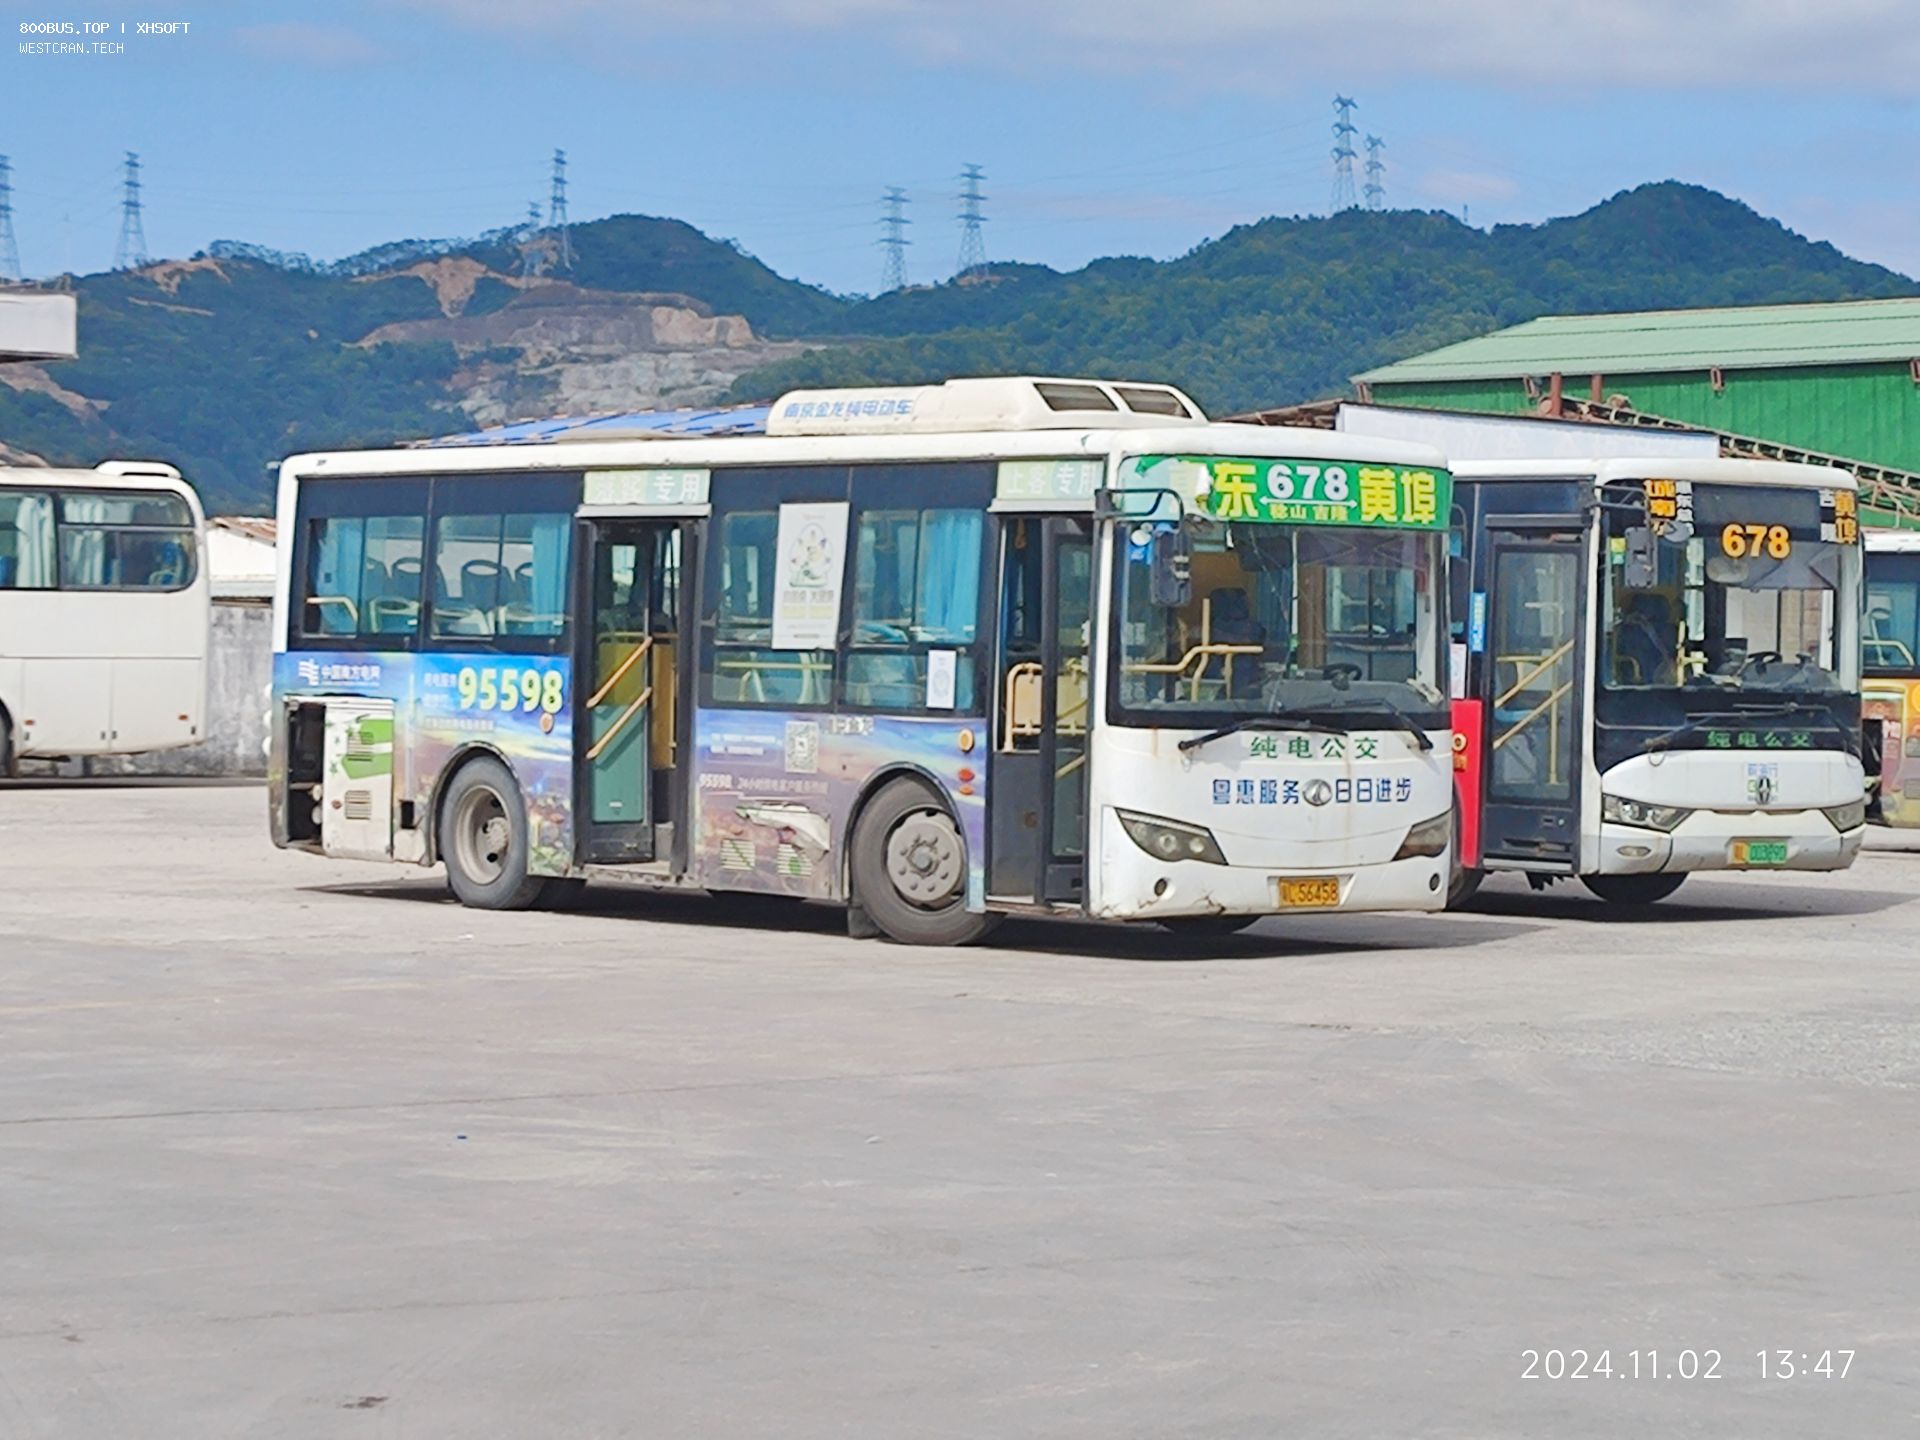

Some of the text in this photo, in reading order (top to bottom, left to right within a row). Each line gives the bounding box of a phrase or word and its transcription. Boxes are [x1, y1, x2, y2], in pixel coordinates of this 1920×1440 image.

[1266, 464, 1350, 500] 678
[1358, 468, 1436, 524] 黄埠
[1721, 523, 1792, 559] 678
[458, 667, 564, 714] 95598
[1250, 736, 1379, 759] 纯电公交
[1212, 777, 1412, 805] 粤惠服务 日日进步
